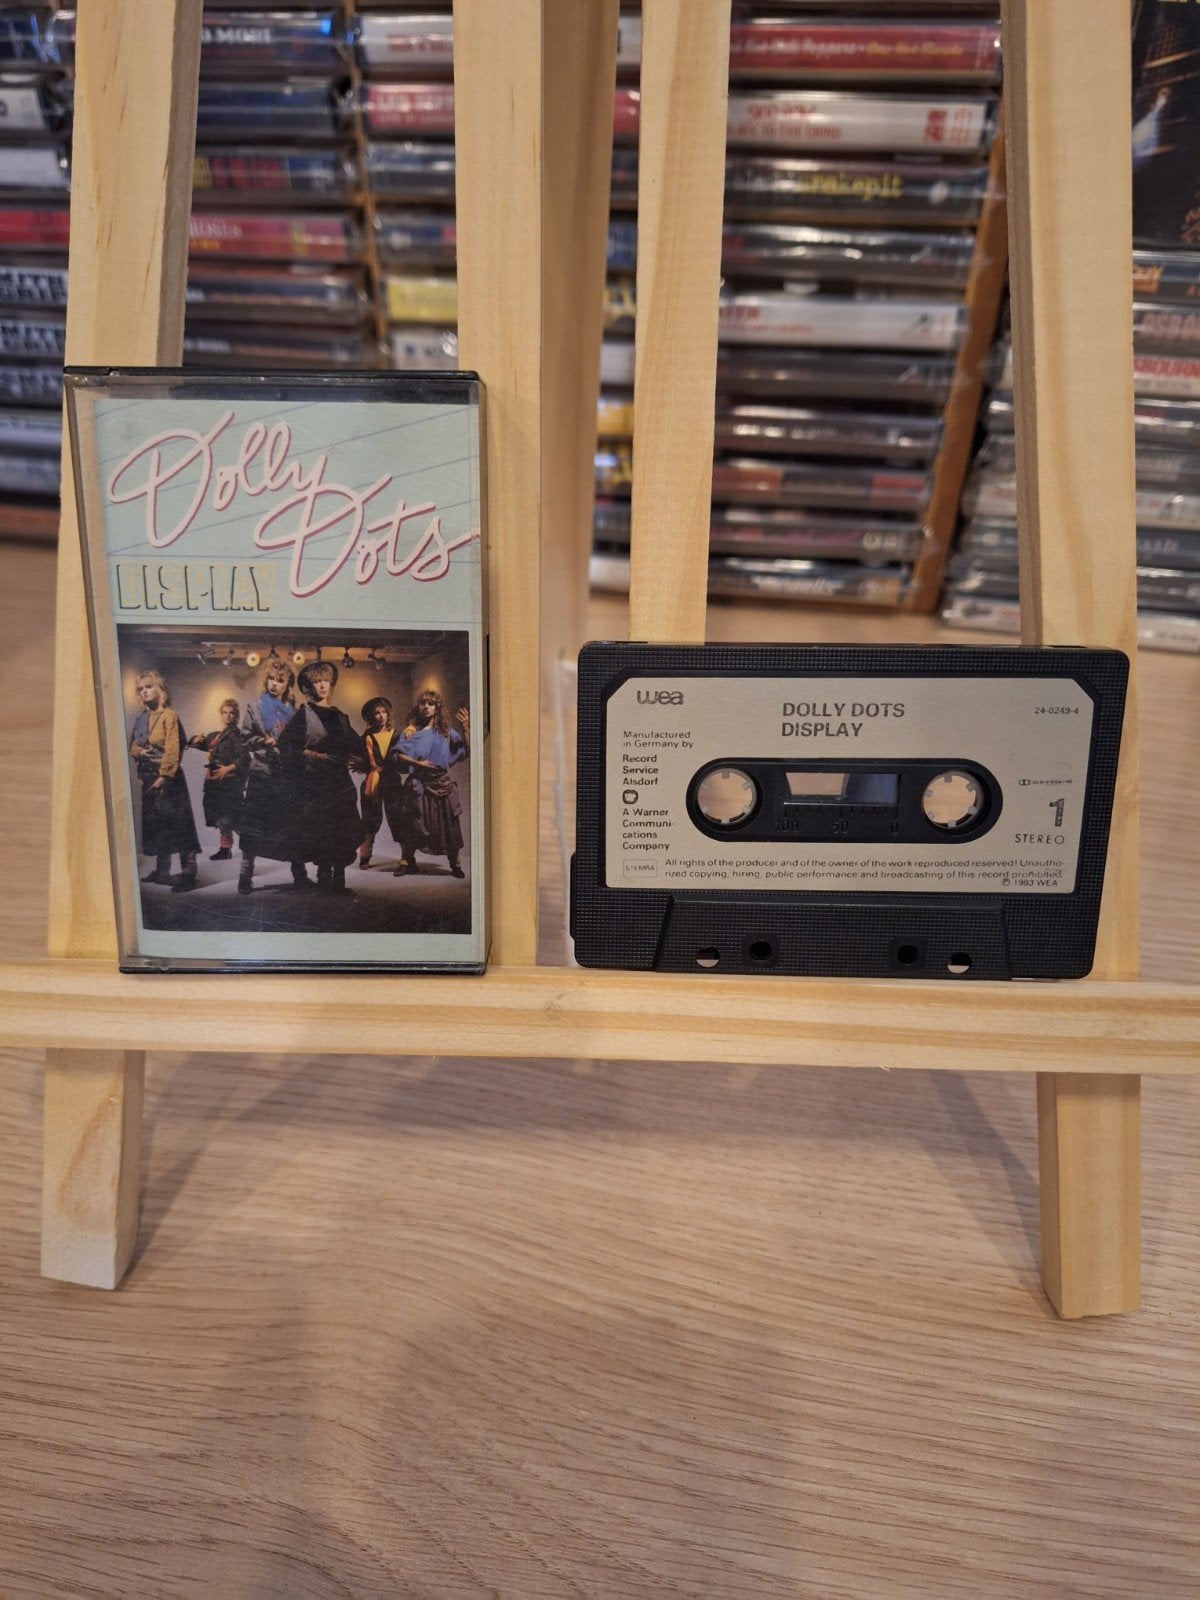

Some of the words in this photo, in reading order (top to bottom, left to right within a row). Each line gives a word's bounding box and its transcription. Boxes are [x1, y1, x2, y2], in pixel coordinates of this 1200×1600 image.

[106, 410, 329, 549] Dolly
[253, 473, 481, 598] Dots
[115, 560, 277, 612] DISPLAY
[636, 690, 684, 705] wea
[782, 702, 846, 717] DOLLY
[851, 702, 905, 718] DOTS
[1034, 706, 1079, 715] 24-0249-4
[781, 722, 864, 737] DISPLAY
[623, 730, 691, 739] Manufactured
[623, 740, 631, 748] in
[634, 740, 679, 749] Germany
[682, 740, 694, 749] by
[622, 754, 658, 763] Record
[622, 766, 659, 774] Service
[622, 777, 659, 786] Alsdorf
[632, 808, 669, 816] Warner
[1049, 798, 1065, 827] 1
[622, 820, 674, 828] Communi-
[622, 831, 658, 839] cations
[1014, 833, 1065, 845] STEREO
[622, 842, 670, 851] Company
[680, 859, 706, 868] rights
[707, 859, 717, 867] of
[718, 859, 734, 867] the
[735, 859, 778, 869] producer
[780, 859, 799, 867] and
[800, 859, 810, 867] of
[811, 859, 826, 867] the
[860, 859, 871, 867] of
[914, 860, 970, 869] reproduced
[664, 870, 687, 878] rized
[765, 870, 794, 879] public
[796, 870, 858, 879] performance
[860, 871, 878, 879] and
[880, 871, 943, 880] broadcasting
[946, 871, 955, 879] of
[957, 871, 975, 879] this
[978, 871, 1009, 879] record
[1014, 879, 1034, 887] 1983
[1037, 879, 1058, 887] WEA
